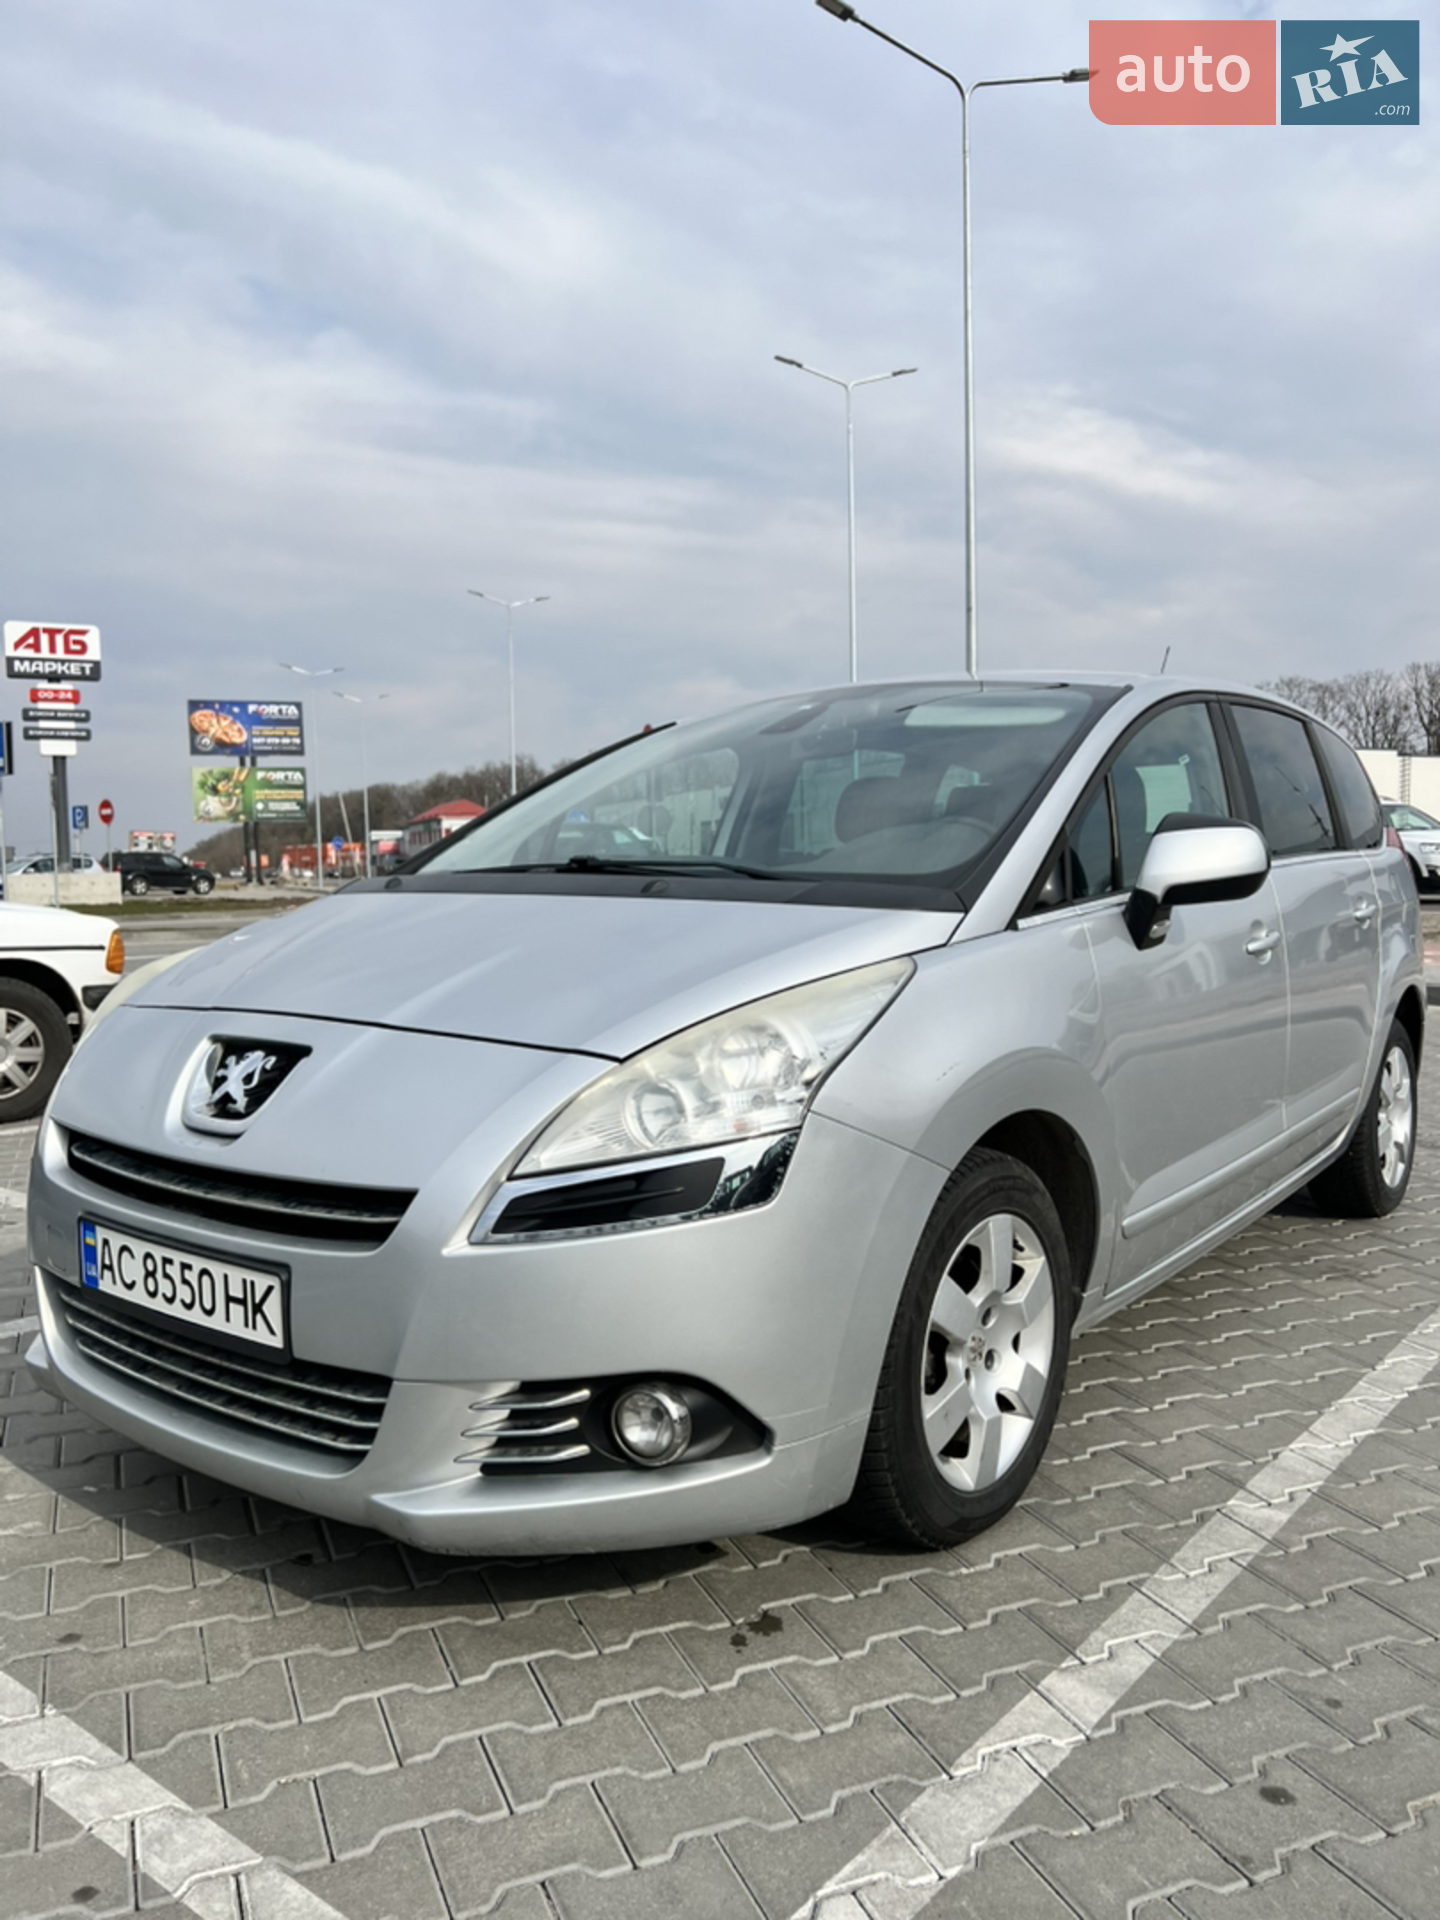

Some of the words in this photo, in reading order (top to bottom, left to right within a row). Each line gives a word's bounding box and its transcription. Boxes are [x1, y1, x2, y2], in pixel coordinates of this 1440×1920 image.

[13, 626, 90, 655] АТБ
[13, 660, 94, 676] МАРКЕТ
[100, 1237, 137, 1291] AC
[143, 1251, 216, 1317] 8550
[223, 1272, 278, 1337] HK
